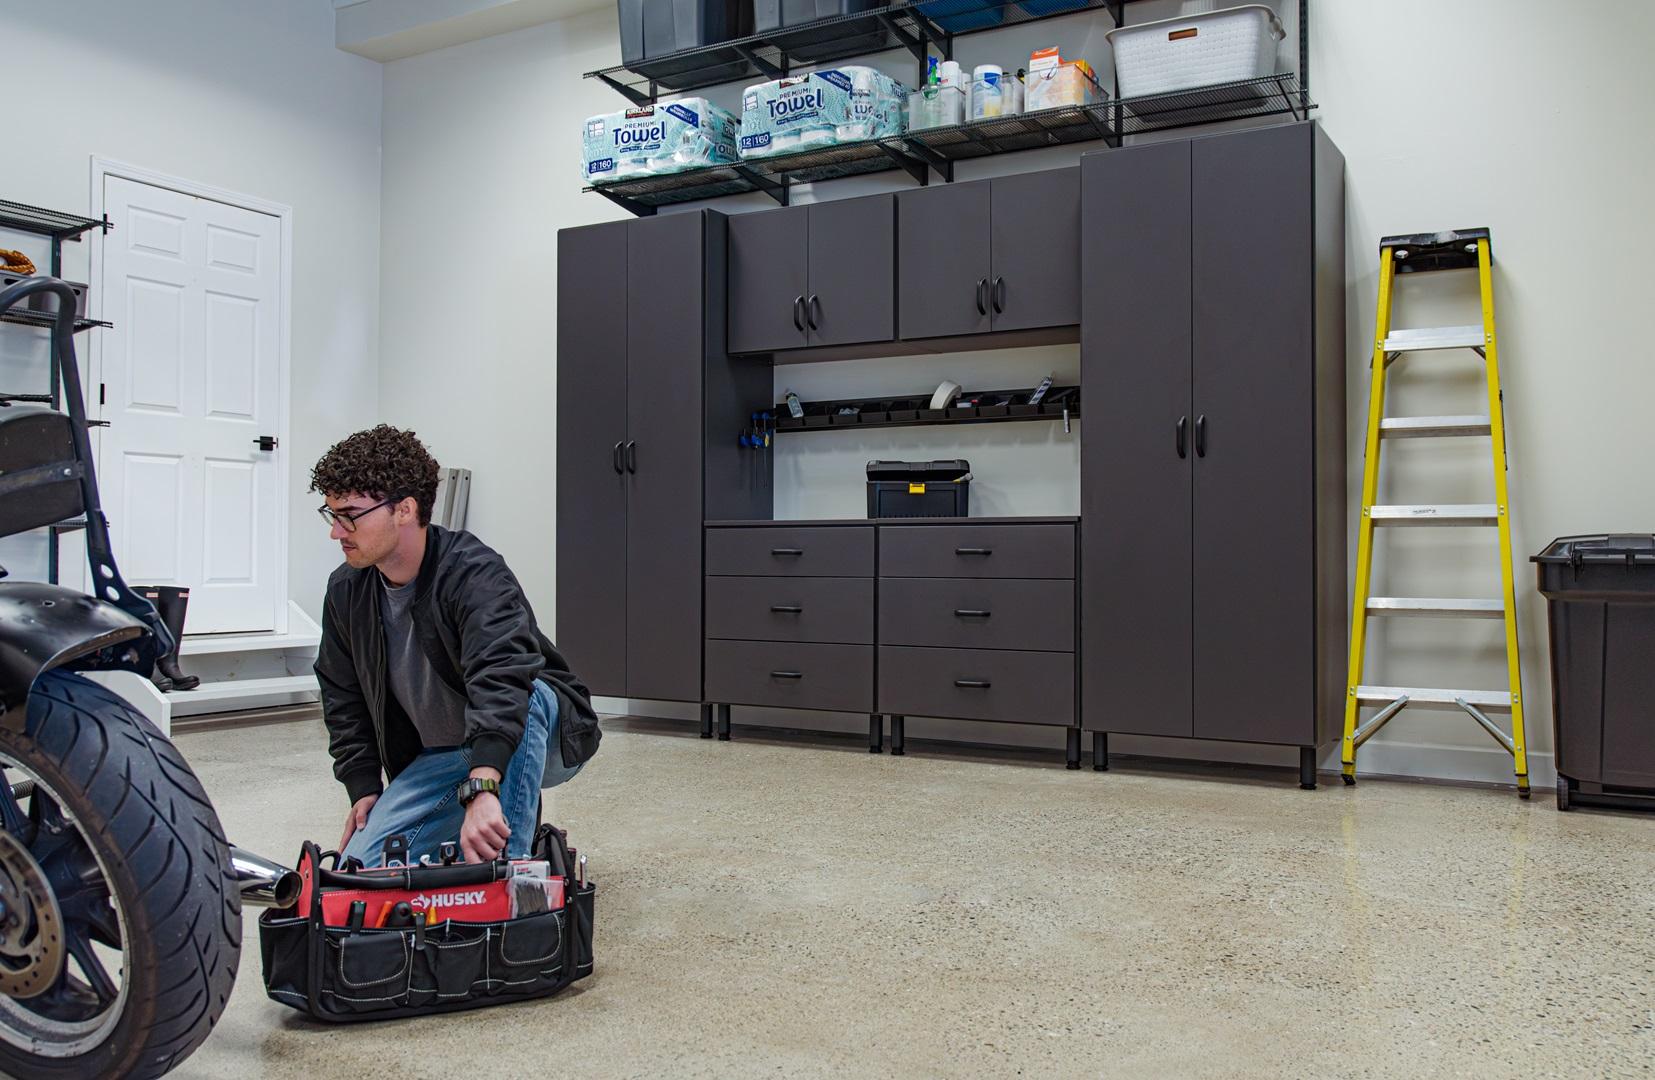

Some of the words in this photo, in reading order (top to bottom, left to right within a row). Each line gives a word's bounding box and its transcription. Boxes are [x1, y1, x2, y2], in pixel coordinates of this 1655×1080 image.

[780, 88, 808, 98] PREMIUM
[766, 88, 822, 117] Towel
[624, 121, 655, 129] PREMIUM
[612, 121, 666, 145] Towel
[742, 138, 752, 146] 12
[755, 134, 769, 143] 160
[599, 160, 612, 169] 160
[431, 890, 486, 907] HUSKY
